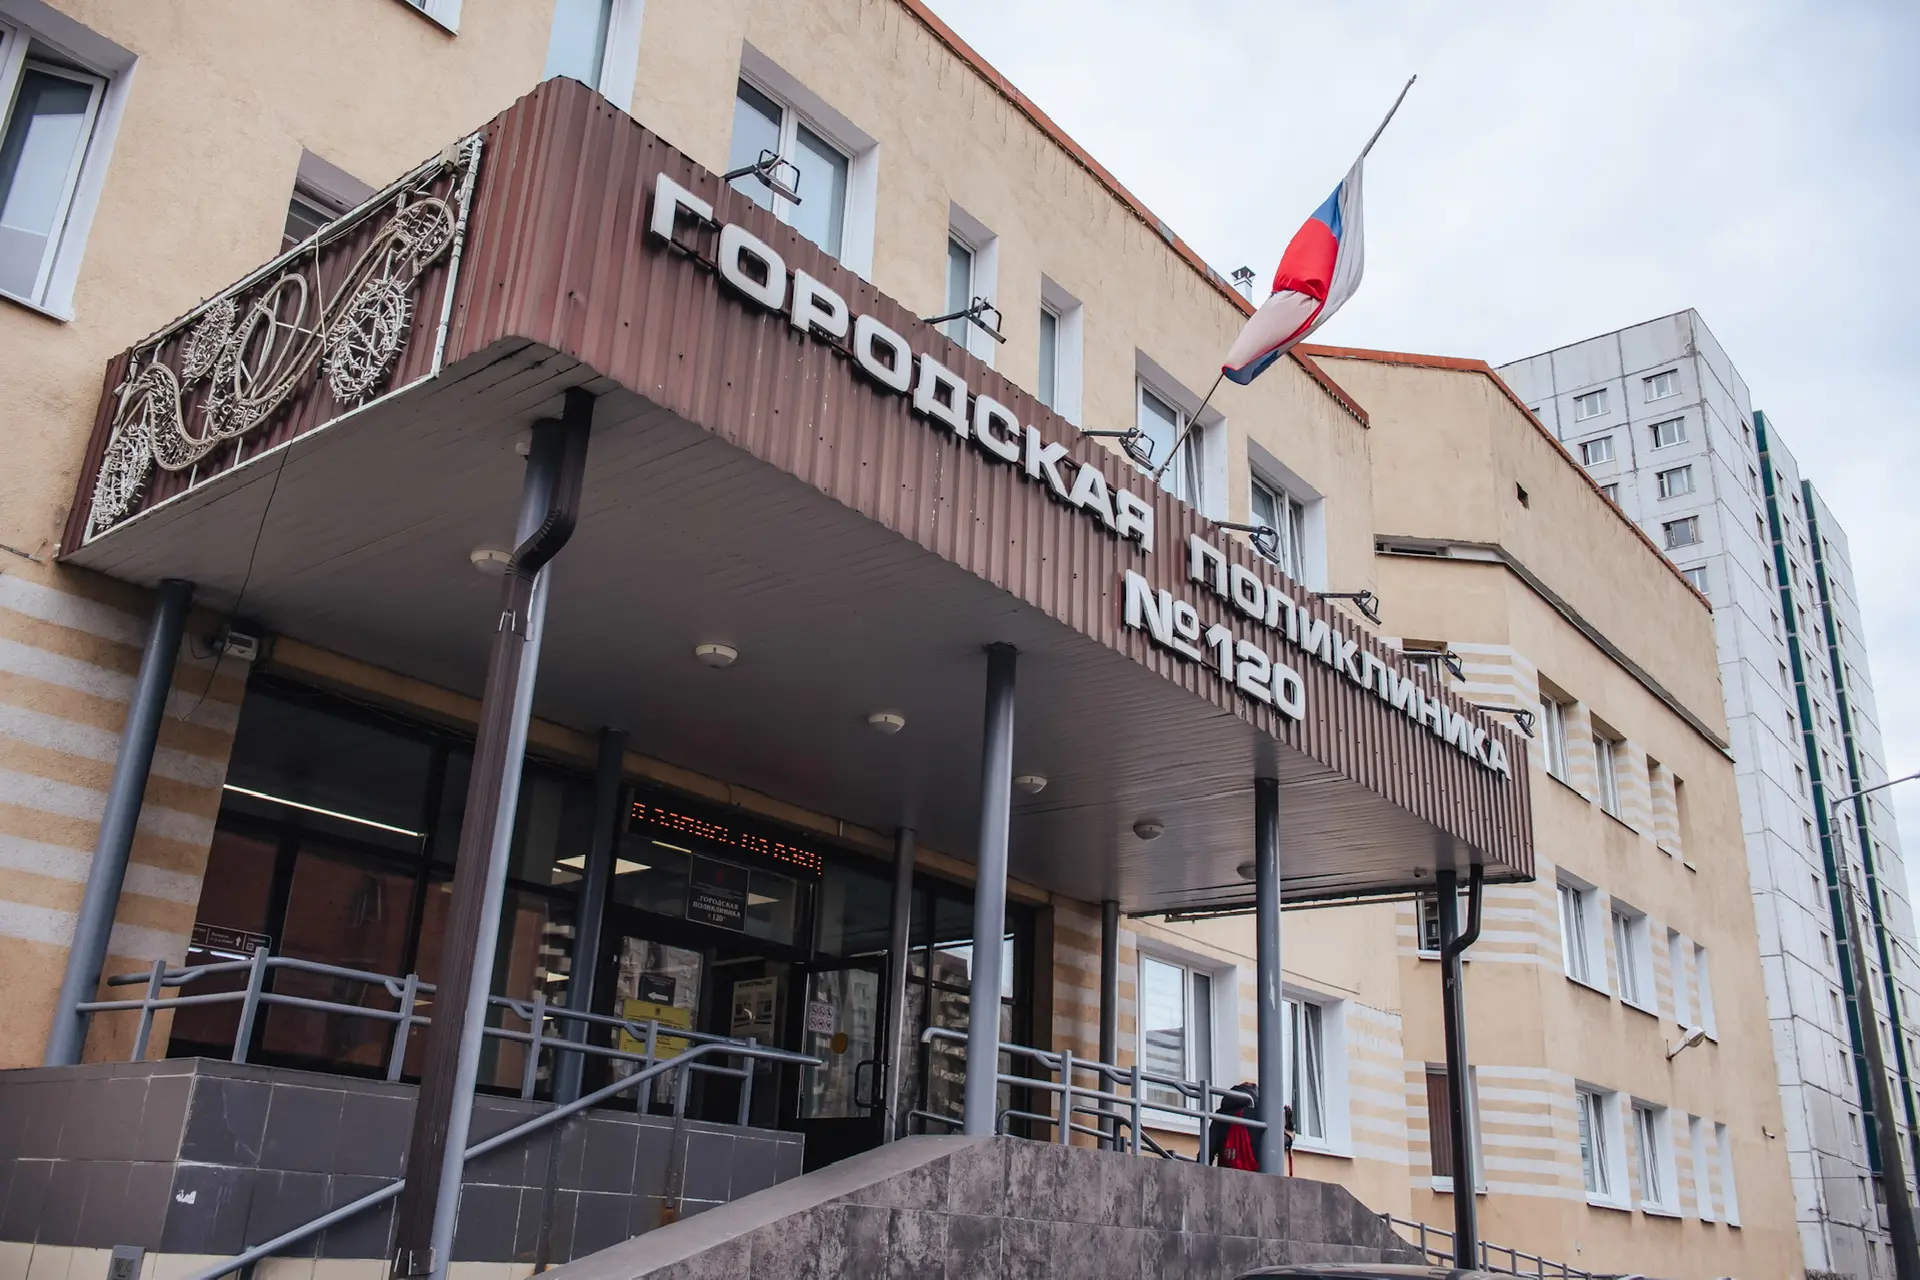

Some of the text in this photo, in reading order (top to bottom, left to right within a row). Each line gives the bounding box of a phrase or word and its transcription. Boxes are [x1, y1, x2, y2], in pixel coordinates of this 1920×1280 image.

[650, 172, 1511, 781] ГОРОДСКАЯ ПОЛИКЛИНИКА
[699, 895, 739, 910] ГОРОДСКАЯ
